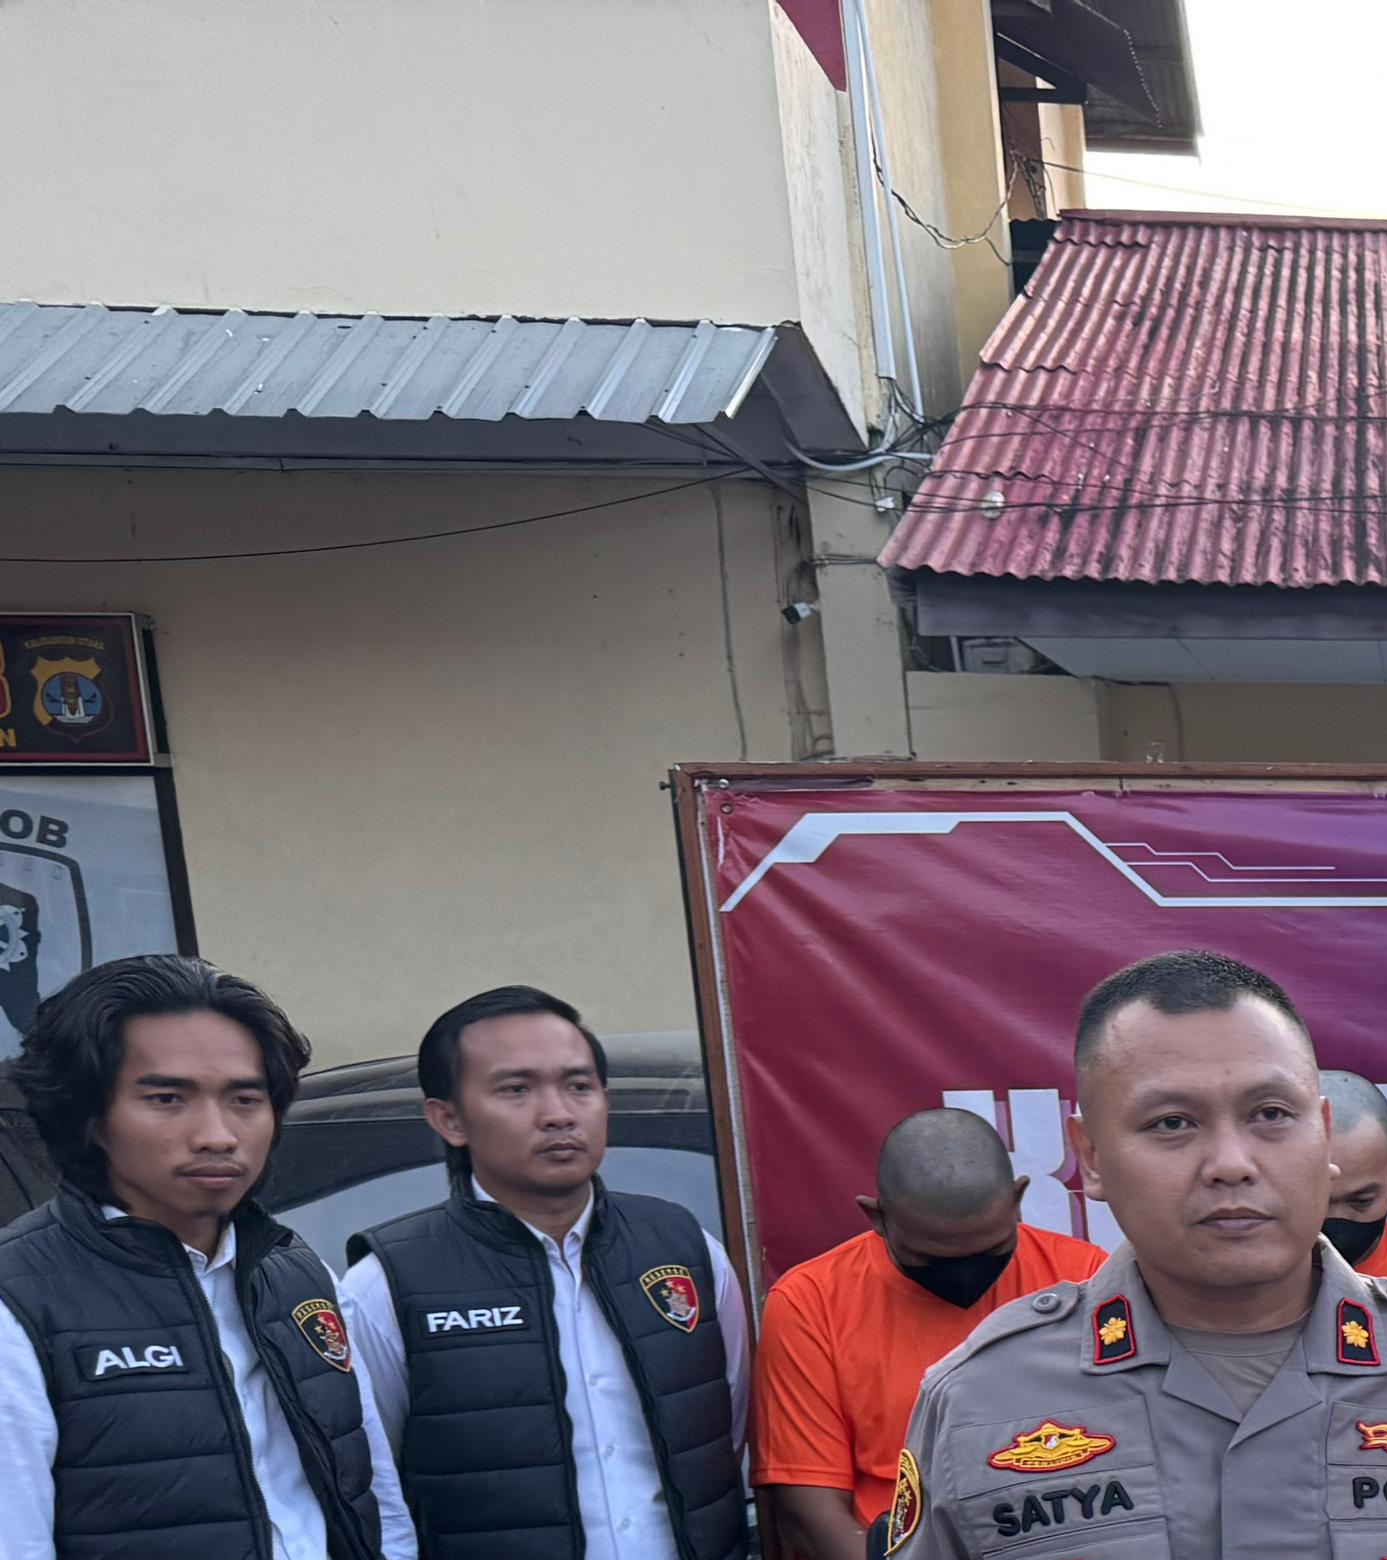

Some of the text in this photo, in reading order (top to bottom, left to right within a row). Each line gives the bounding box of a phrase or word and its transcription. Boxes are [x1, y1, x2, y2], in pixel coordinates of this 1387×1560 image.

[426, 1306, 524, 1333] FARIZ
[95, 1345, 183, 1376] ALGI
[993, 1481, 1135, 1537] SATYA
